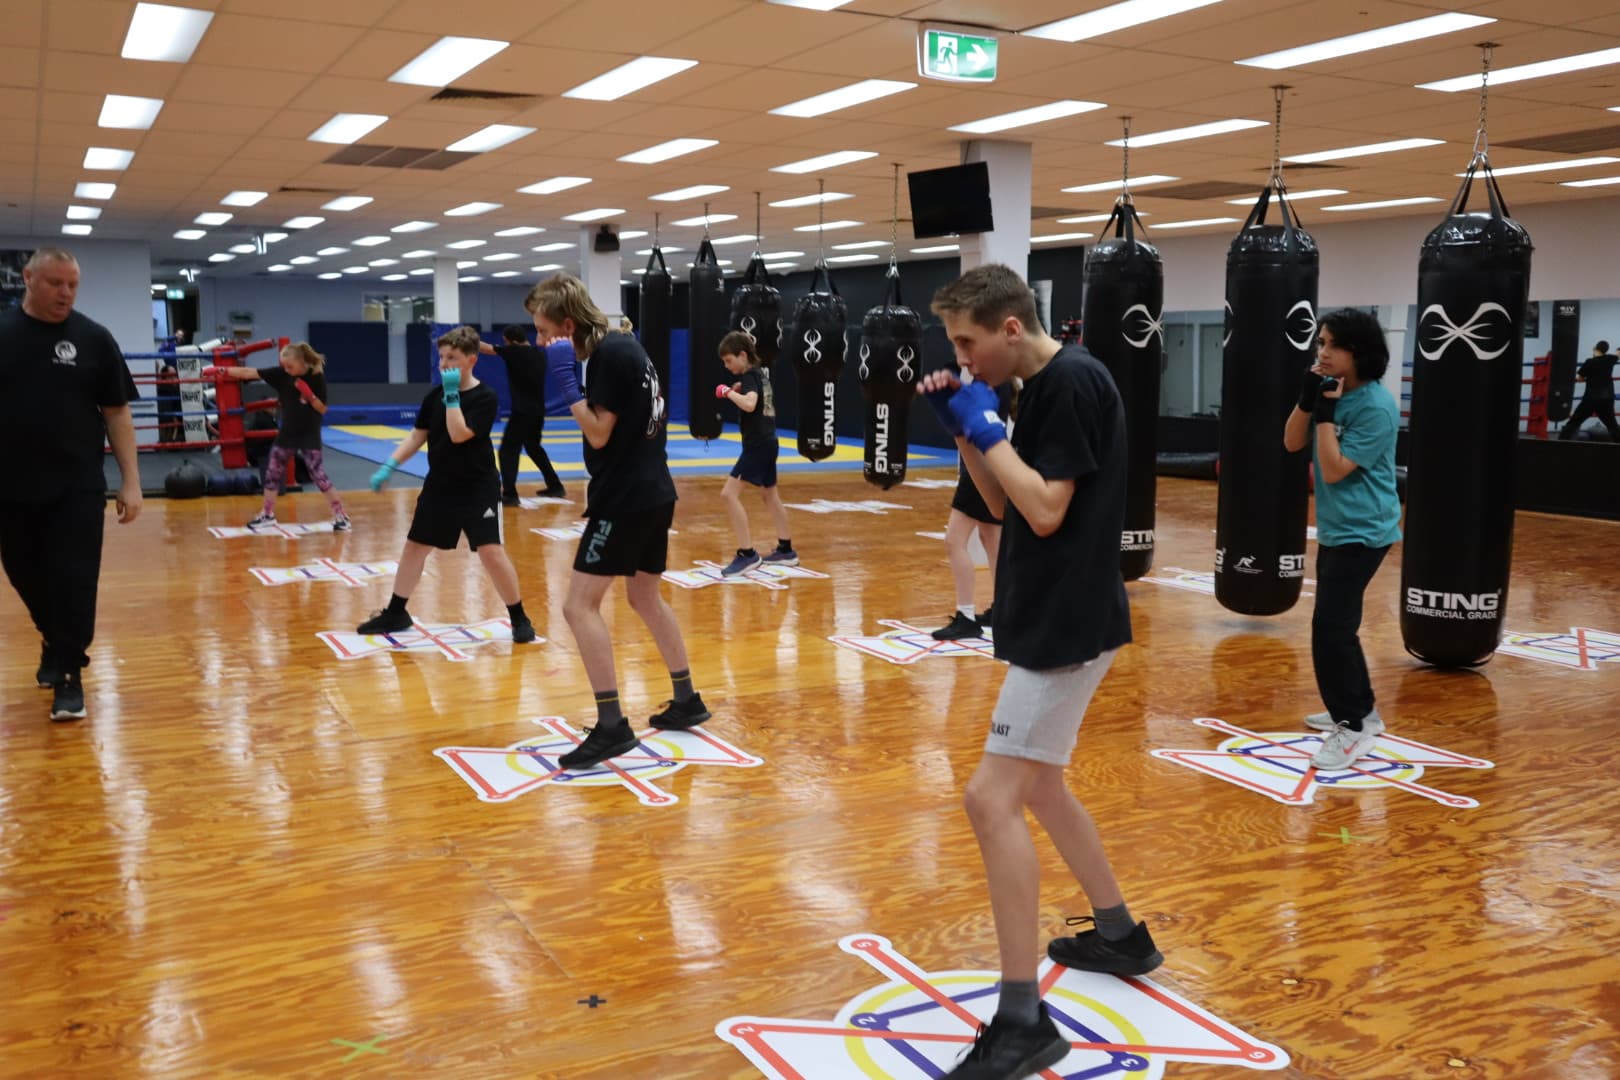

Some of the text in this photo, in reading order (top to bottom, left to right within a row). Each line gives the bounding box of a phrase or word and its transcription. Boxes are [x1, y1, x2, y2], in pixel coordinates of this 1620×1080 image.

[824, 382, 835, 447] STING
[875, 403, 889, 474] STING
[585, 519, 612, 564] FILA
[1407, 587, 1499, 611] STING
[1406, 604, 1497, 620] COMMERCIAL GRADE
[858, 1015, 877, 1025] 2
[1120, 1058, 1139, 1068] 3
